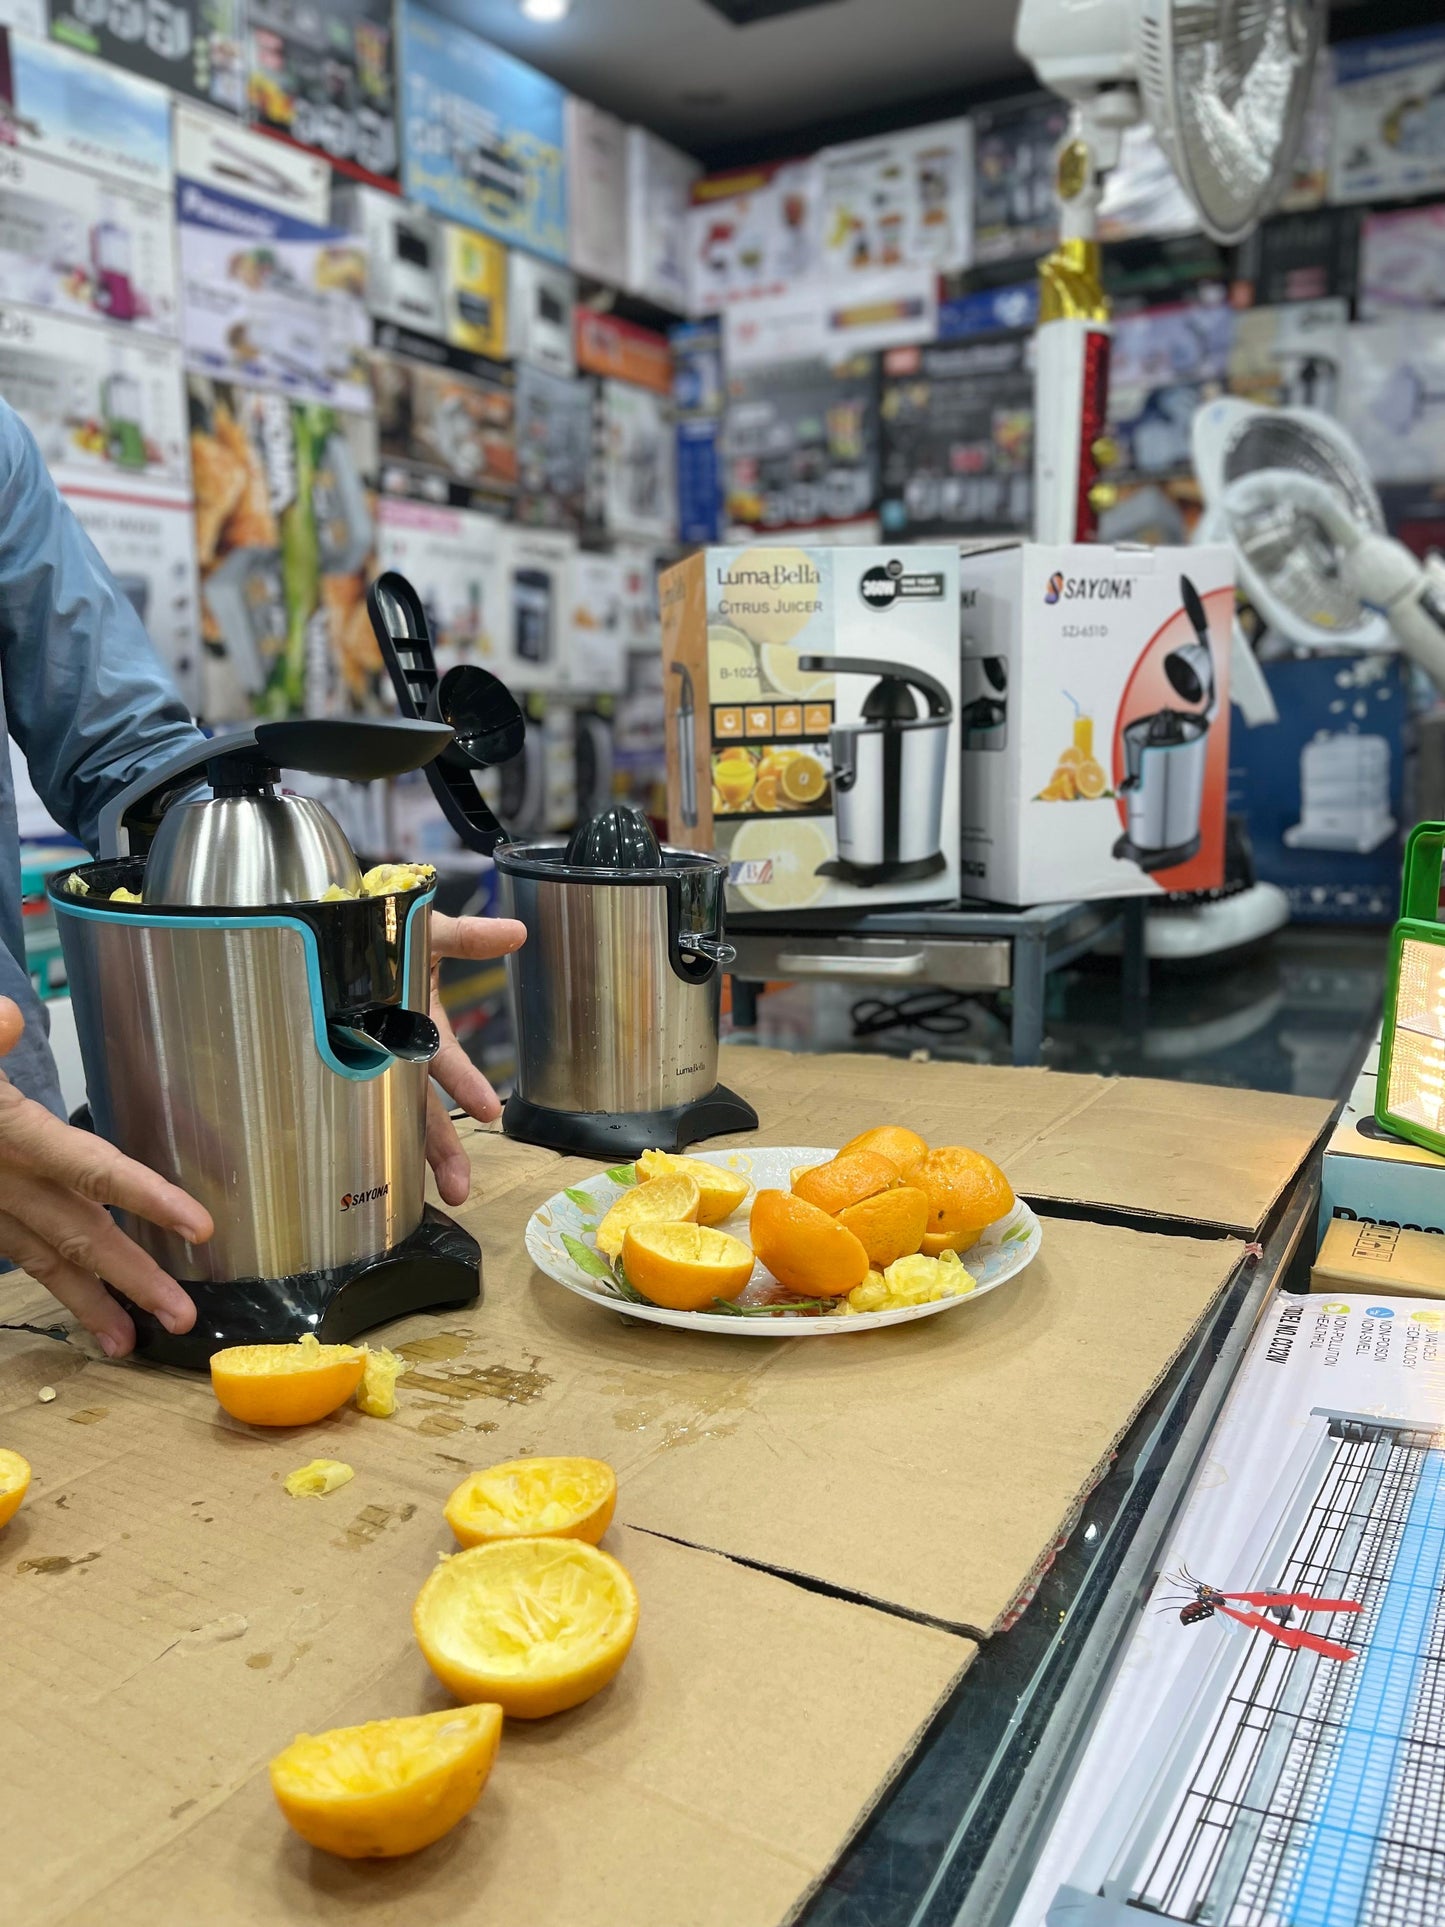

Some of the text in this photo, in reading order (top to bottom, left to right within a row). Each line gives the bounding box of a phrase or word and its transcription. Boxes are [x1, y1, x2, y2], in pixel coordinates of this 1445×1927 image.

[717, 564, 821, 589] LumaBella
[1065, 578, 1132, 599] SAYONA
[720, 667, 761, 679] B-1022
[352, 1184, 389, 1206] SAYONA
[1279, 1305, 1304, 1323] ODEL
[1309, 1313, 1330, 1349] HEALTHFUL
[1324, 1316, 1348, 1367] NON-POLLUTION
[1374, 1320, 1393, 1363] NON-POISON
